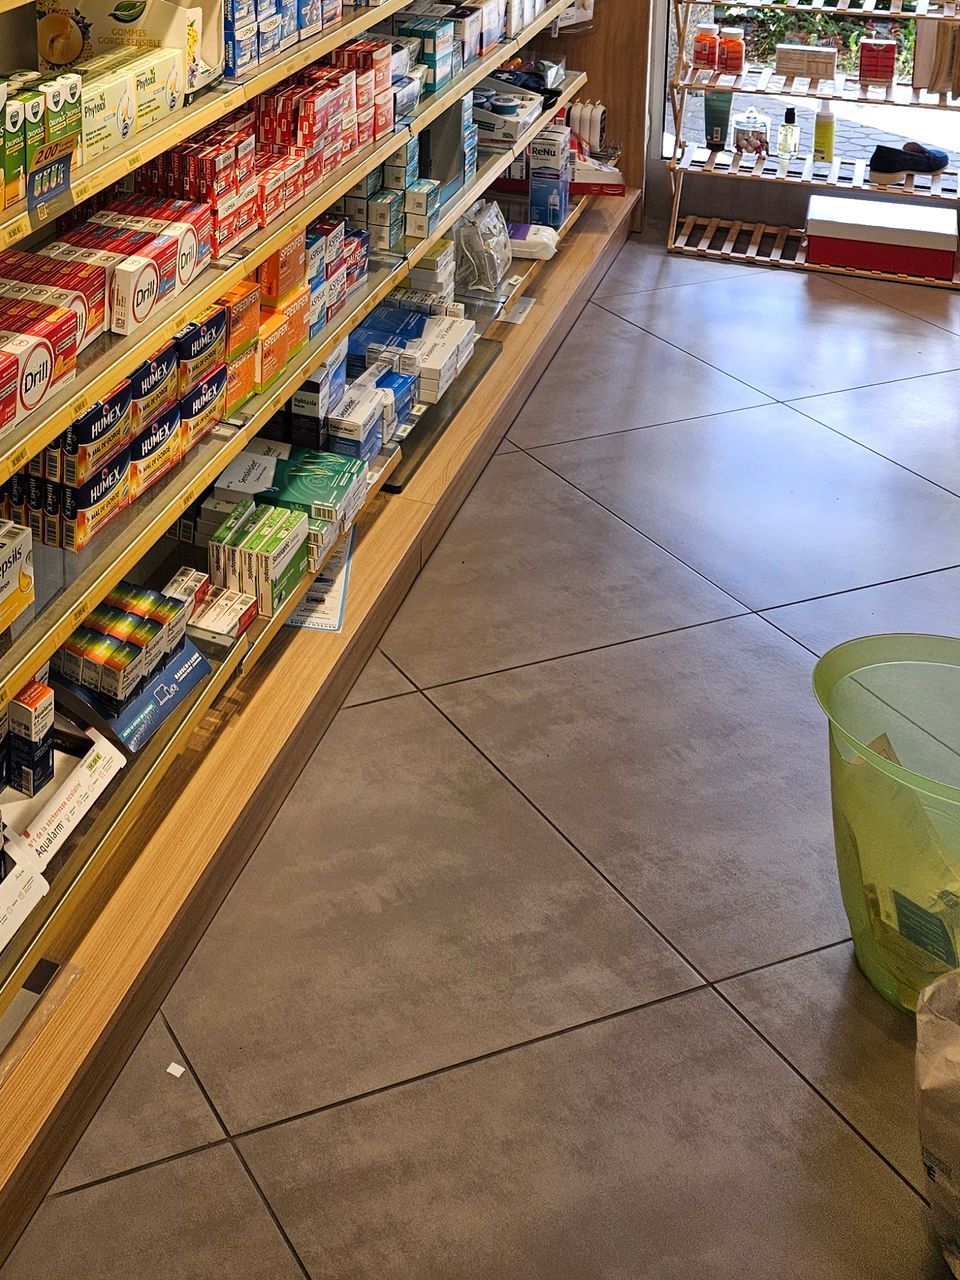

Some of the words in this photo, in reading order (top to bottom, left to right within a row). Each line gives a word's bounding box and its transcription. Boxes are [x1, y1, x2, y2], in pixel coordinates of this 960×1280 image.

[98, 36, 126, 46] GORGE
[127, 38, 162, 47] SENSIBLE
[112, 29, 148, 37] GOMMES
[532, 147, 557, 158] ReNu
[136, 279, 155, 305] Drill
[192, 326, 218, 356] HUMEX
[24, 363, 49, 393] Drill
[92, 403, 121, 439] HUMEX
[141, 423, 170, 456] HUMEX
[35, 822, 64, 858] Aqualarm
